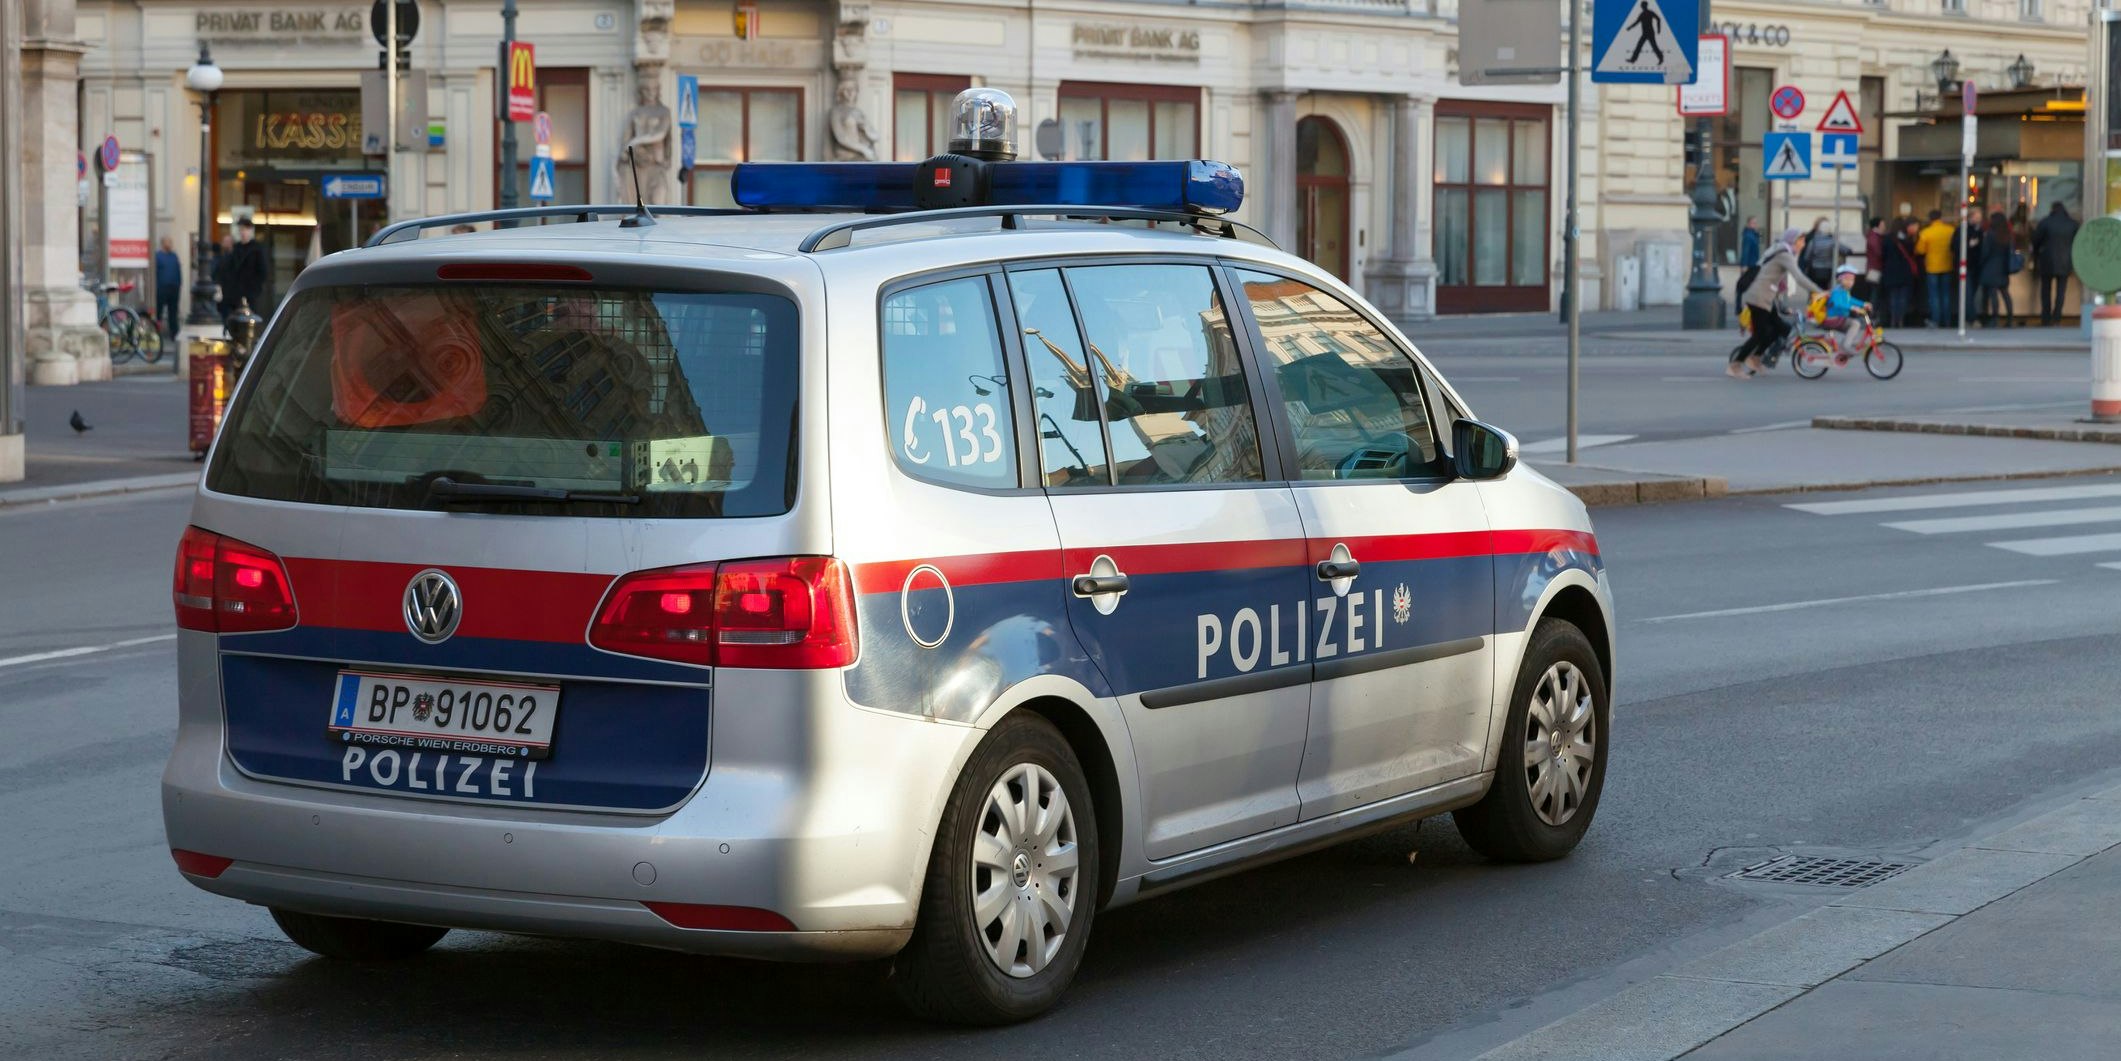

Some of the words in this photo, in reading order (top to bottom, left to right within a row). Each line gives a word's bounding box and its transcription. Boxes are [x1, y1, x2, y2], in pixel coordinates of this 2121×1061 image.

[196, 12, 263, 32] PRIVAT
[270, 12, 326, 32] BANK
[334, 12, 363, 32] AG
[1711, 22, 1742, 43] ACK
[1747, 24, 1759, 45] &
[1764, 25, 1790, 47] CO
[1131, 25, 1173, 49] BANK
[1179, 30, 1200, 50] AG
[932, 403, 1003, 467] 133
[1197, 588, 1384, 679] POLIZEI
[340, 707, 350, 720] A
[368, 684, 410, 724] BP
[434, 689, 537, 734] 91062
[354, 733, 415, 747] PORSCHE
[418, 738, 451, 750] WIEN
[453, 741, 517, 756] ERDBERG
[341, 745, 537, 798] POLIZEI
